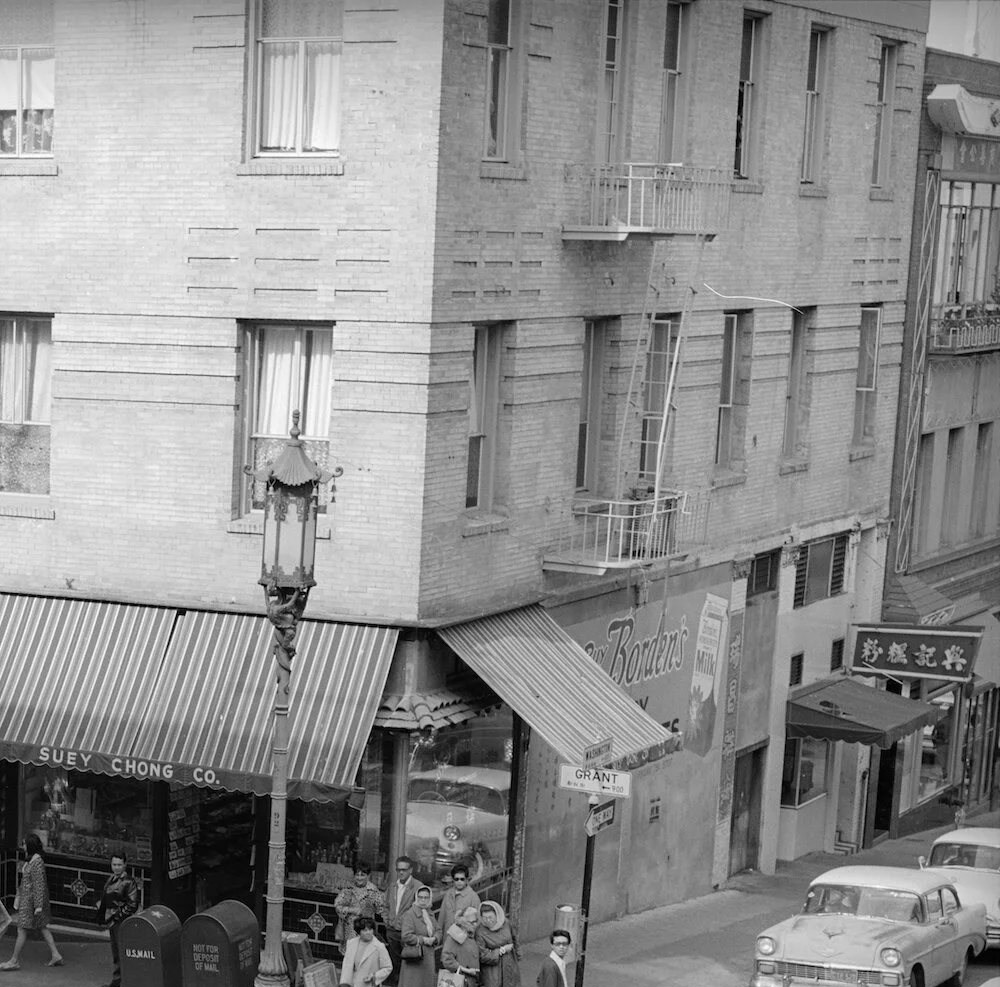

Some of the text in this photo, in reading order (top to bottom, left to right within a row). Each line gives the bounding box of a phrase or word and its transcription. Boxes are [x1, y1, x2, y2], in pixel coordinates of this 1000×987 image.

[607, 609, 689, 687] Borden's
[696, 650, 715, 676] Milk
[39, 746, 221, 785] SUEY CHONG CO.
[575, 769, 619, 784] GRANT
[193, 944, 219, 953] NOT FOR
[193, 953, 219, 963] DEPOSIT
[195, 962, 204, 971] OF
